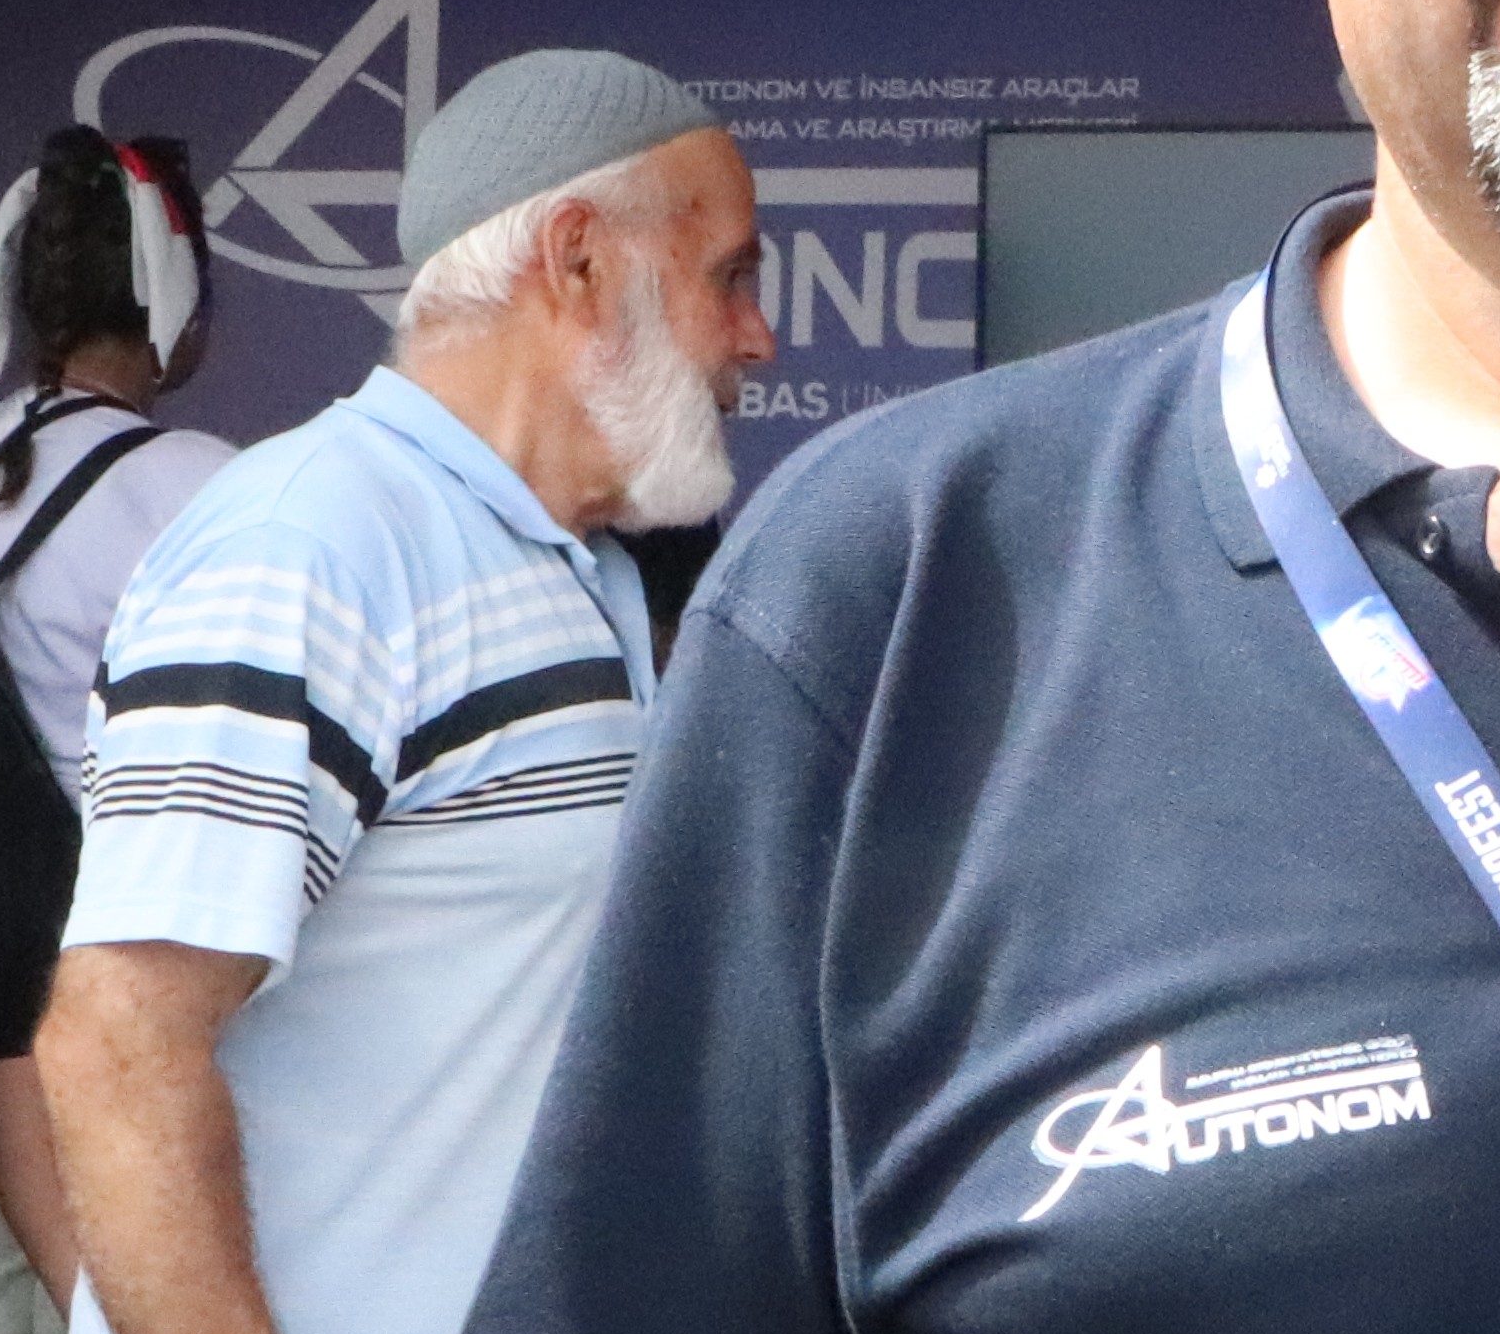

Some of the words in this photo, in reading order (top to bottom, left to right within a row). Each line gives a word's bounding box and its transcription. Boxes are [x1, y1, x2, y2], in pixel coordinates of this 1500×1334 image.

[817, 80, 852, 100] VE
[1001, 77, 1140, 106] ARAÇLAR
[797, 119, 832, 140] VE
